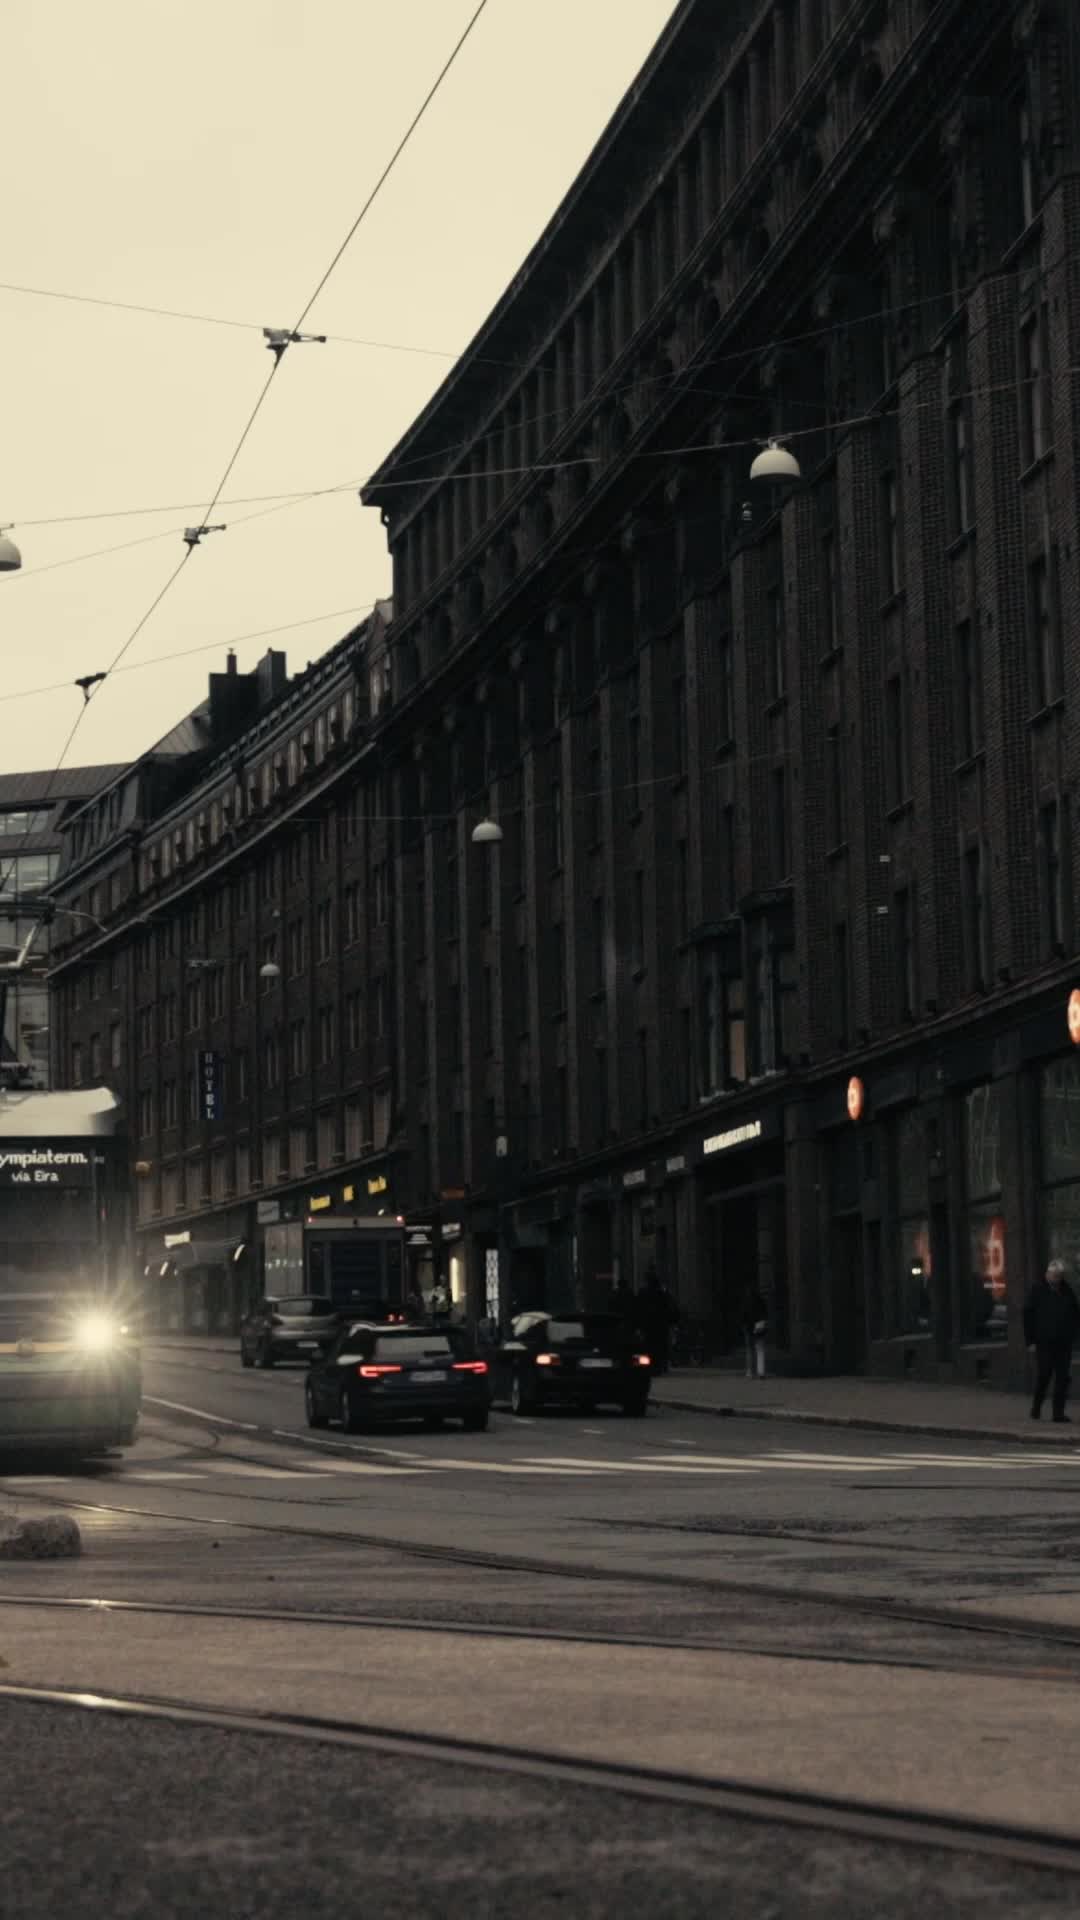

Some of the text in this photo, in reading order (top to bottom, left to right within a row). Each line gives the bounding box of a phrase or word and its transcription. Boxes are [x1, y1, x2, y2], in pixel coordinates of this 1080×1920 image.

[204, 1052, 215, 1120] HOTEL
[11, 1170, 59, 1182] via Eira
